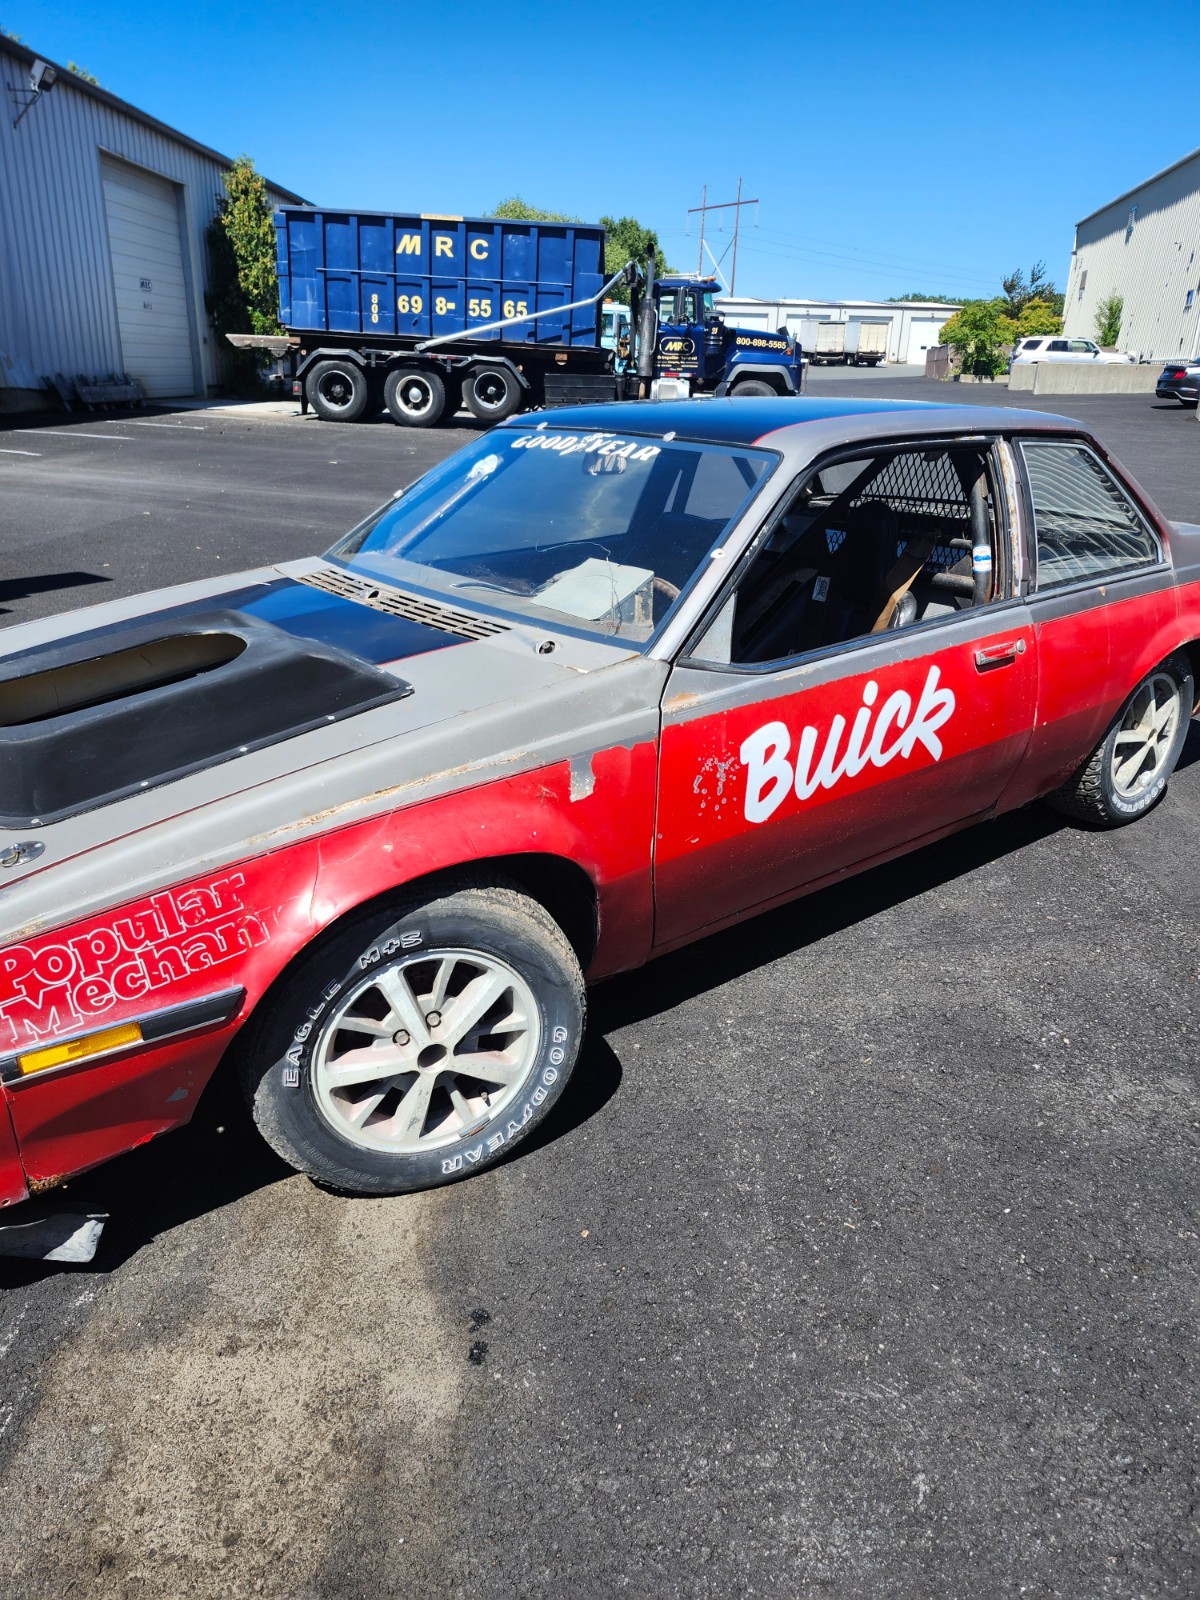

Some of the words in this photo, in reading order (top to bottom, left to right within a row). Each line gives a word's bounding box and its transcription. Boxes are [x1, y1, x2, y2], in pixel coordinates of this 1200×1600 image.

[665, 341, 689, 351] MRC
[736, 337, 787, 349] 800-698-5565
[740, 665, 955, 823] Buick
[0, 872, 246, 1001] Popular
[359, 931, 423, 970] M+S
[283, 979, 342, 1088] EAGLE
[442, 1026, 568, 1174] GOODYEAR
